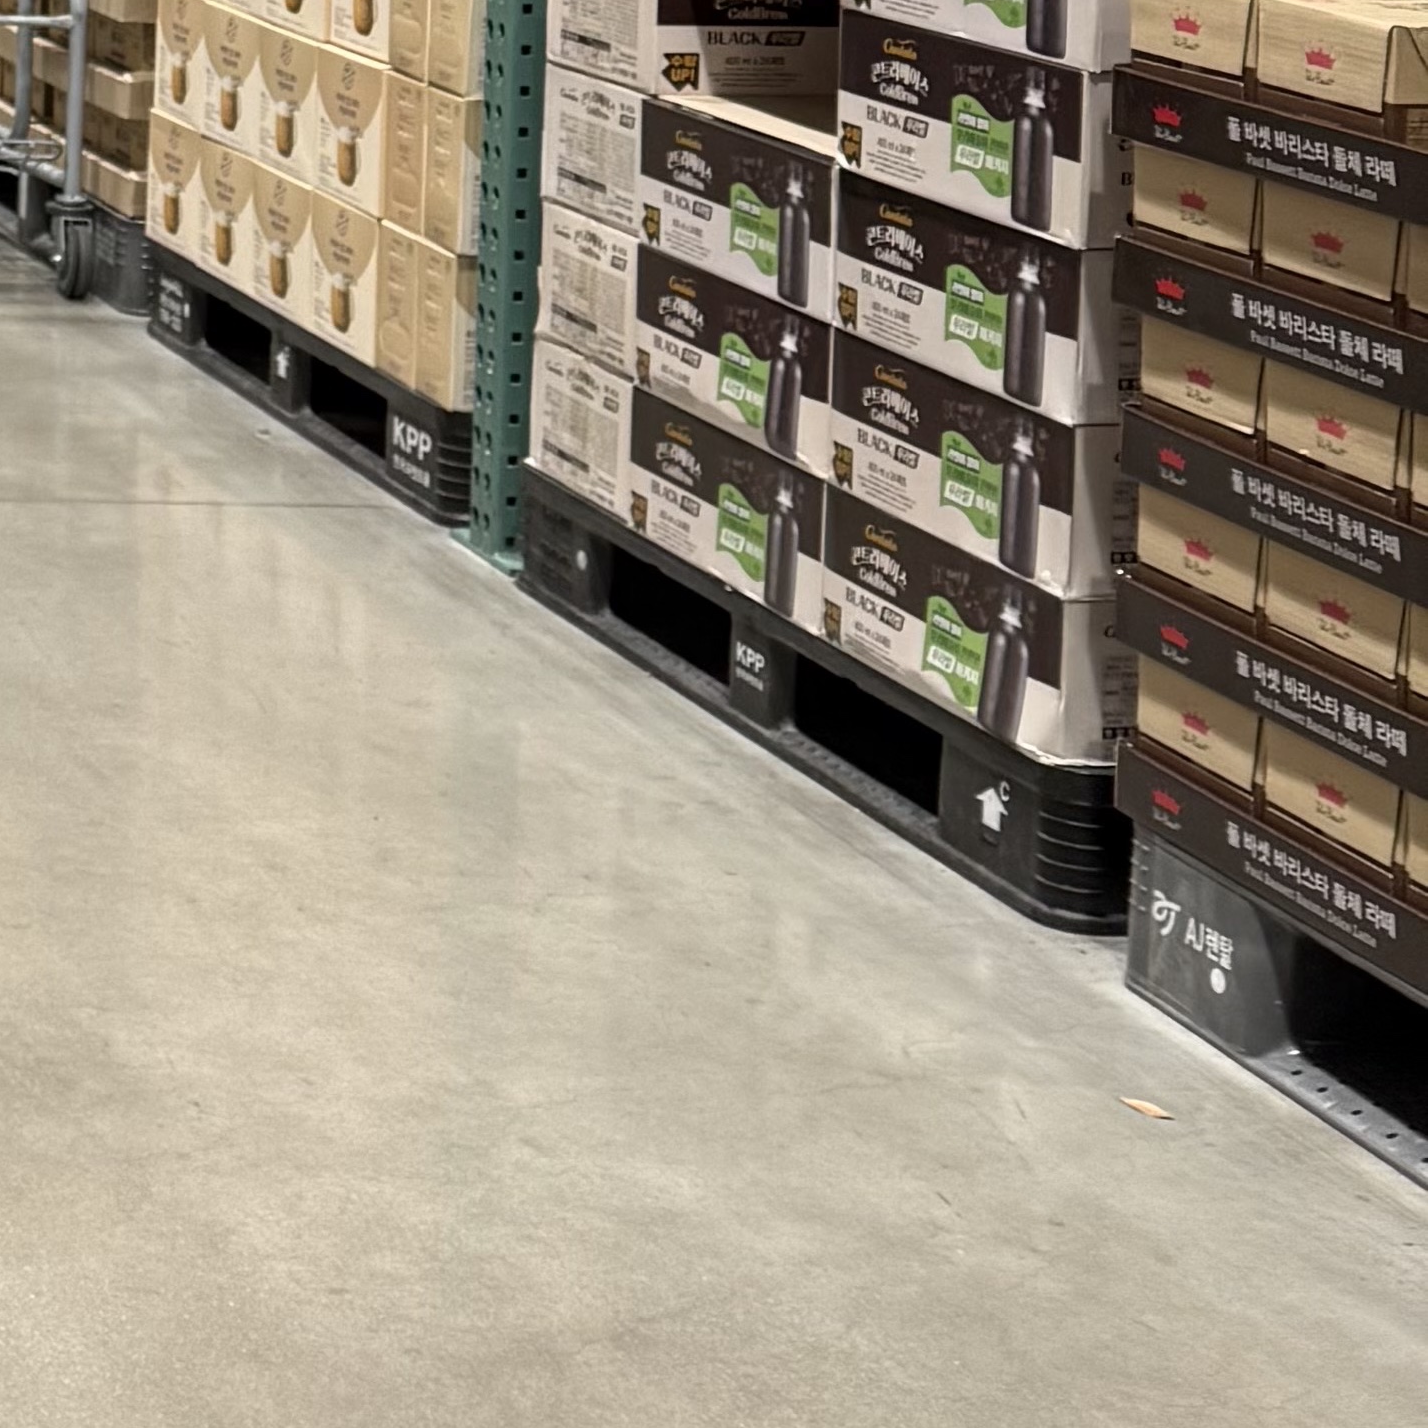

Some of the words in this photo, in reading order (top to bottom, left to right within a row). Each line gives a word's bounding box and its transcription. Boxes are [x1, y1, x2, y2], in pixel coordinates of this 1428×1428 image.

[707, 30, 763, 46] BLACK
[670, 68, 696, 82] UP!
[866, 104, 902, 131] BLACK
[1243, 120, 1273, 152] 바셋
[1274, 129, 1330, 169] 바리스타
[1331, 146, 1363, 178] 돌체
[1364, 155, 1397, 188] 라떼
[860, 267, 897, 296] BLACK
[1247, 299, 1277, 331] 바셋
[1279, 308, 1336, 351] 바리스타
[1338, 329, 1370, 364] 돌체
[1371, 340, 1404, 376] 라떼
[393, 414, 433, 462] KPP
[856, 427, 893, 459] BLACK
[1247, 476, 1276, 508] 바셋
[1277, 488, 1335, 534] 바리스타
[1336, 513, 1368, 549] 돌체
[1369, 526, 1402, 563] 라떼
[845, 586, 880, 616] BLACK
[735, 641, 766, 672] KPP
[1252, 659, 1281, 692] 바셋
[1283, 672, 1340, 724] 바리스타
[1342, 702, 1374, 741] 돌체
[1375, 719, 1408, 758] 라떼
[1242, 830, 1272, 868] 바셋
[1273, 846, 1330, 900] 바리스타
[1365, 900, 1397, 939] 라떼
